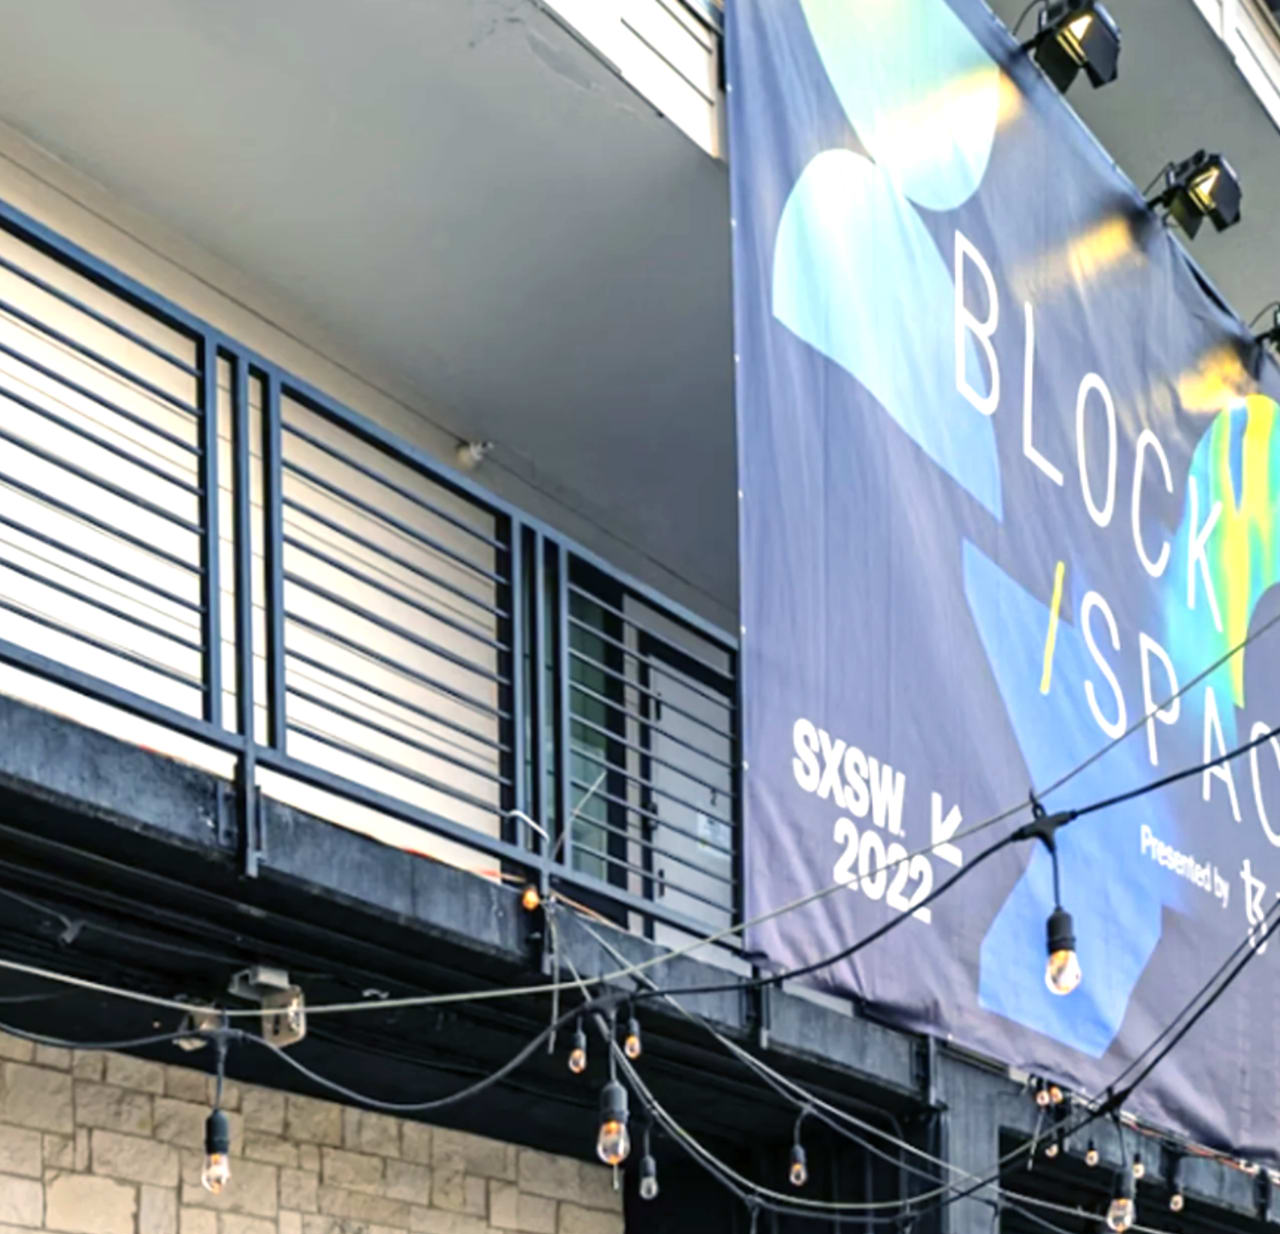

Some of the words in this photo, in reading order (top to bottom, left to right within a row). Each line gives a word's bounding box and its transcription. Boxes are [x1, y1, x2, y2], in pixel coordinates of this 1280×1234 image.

[954, 229, 1224, 633] BLOCK
[832, 816, 934, 925] 2022
[1140, 824, 1212, 892] Presented
[1213, 866, 1230, 909] by
